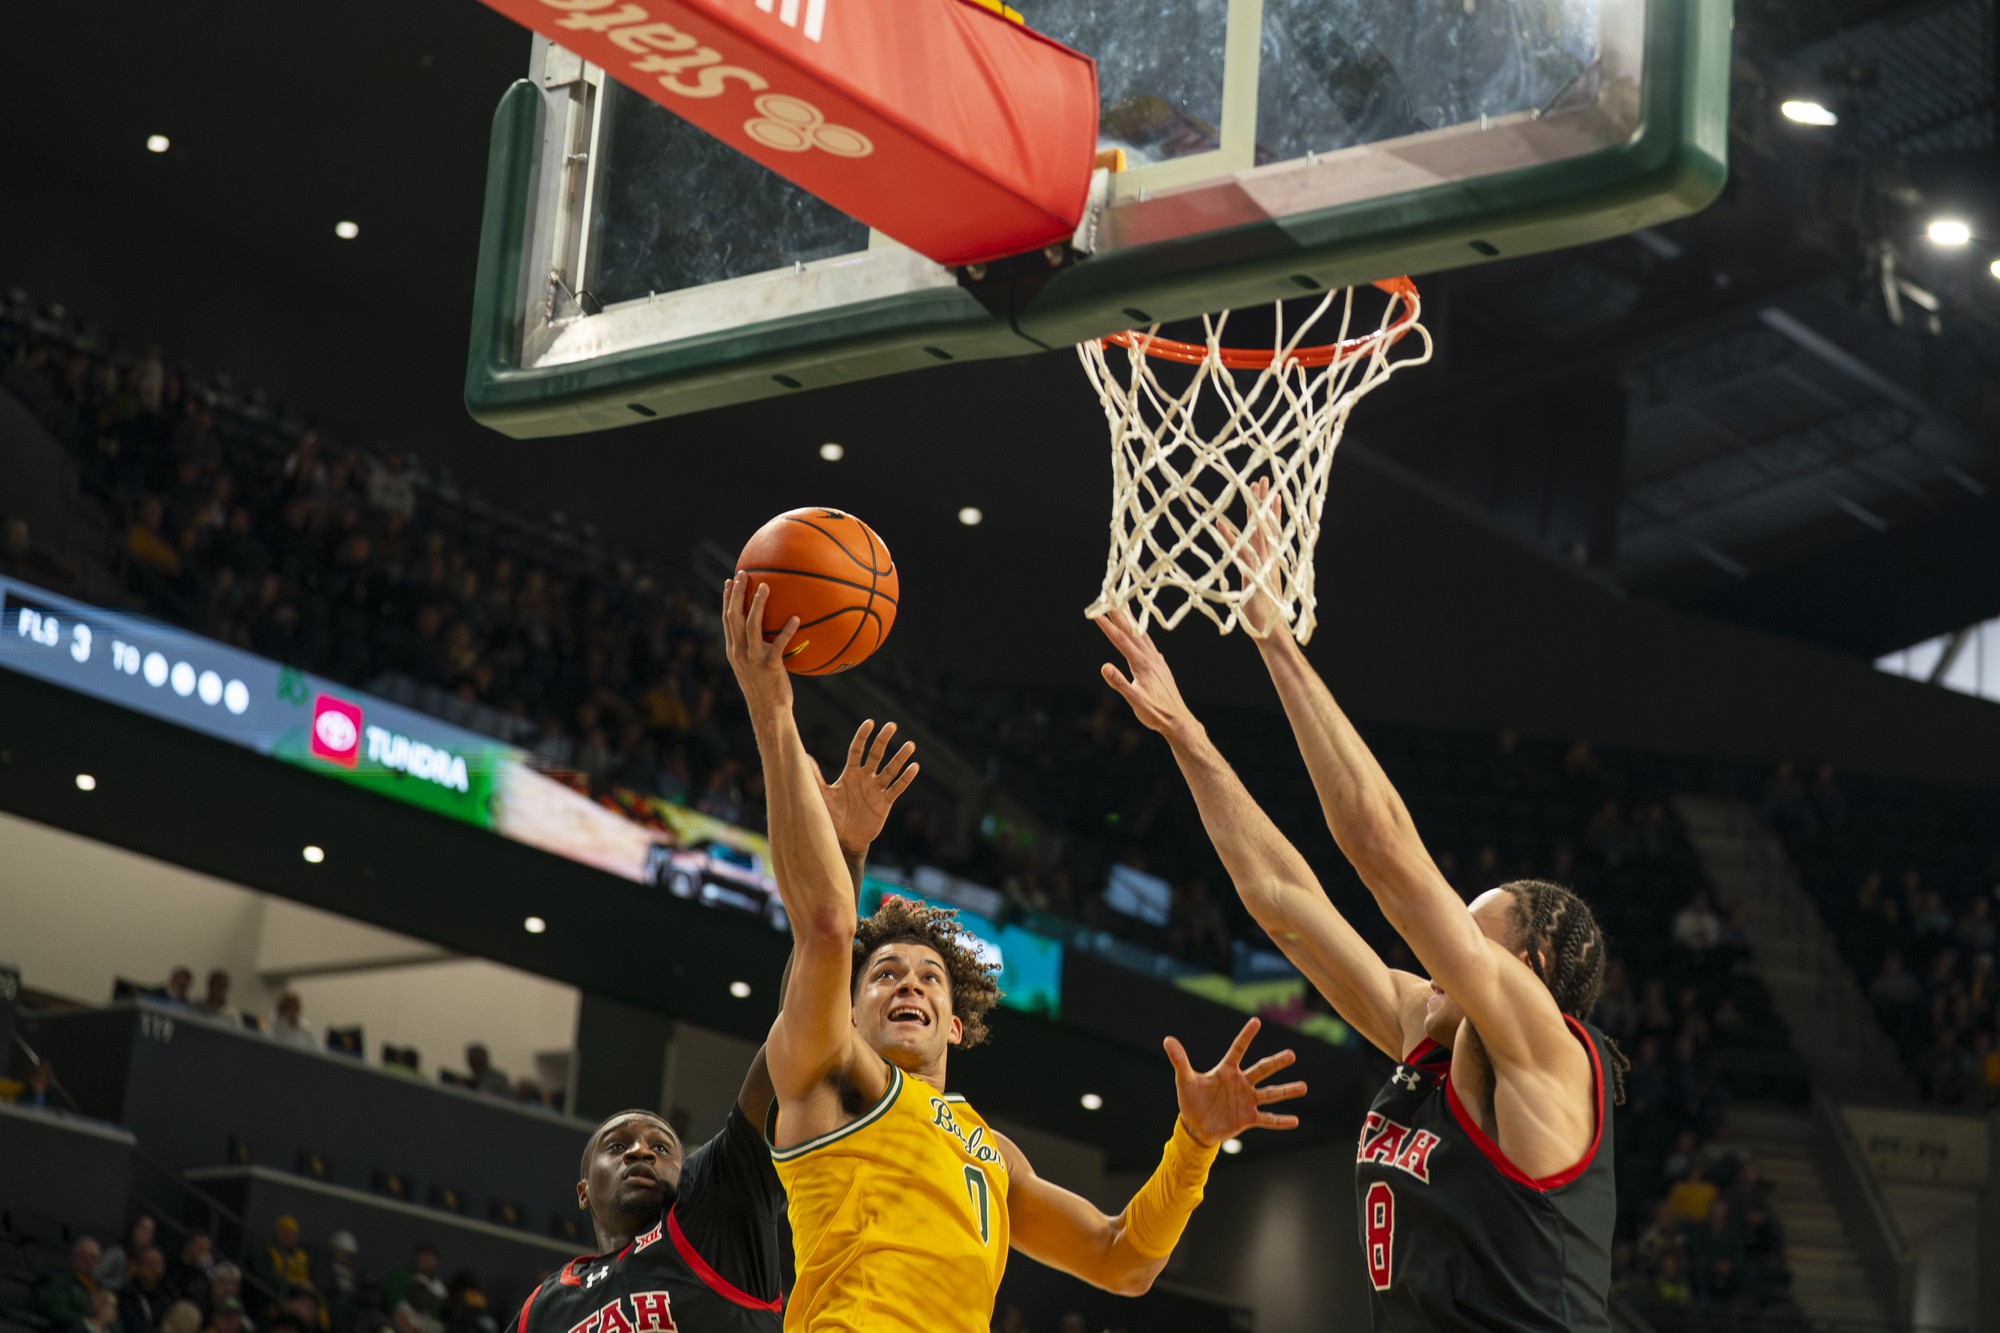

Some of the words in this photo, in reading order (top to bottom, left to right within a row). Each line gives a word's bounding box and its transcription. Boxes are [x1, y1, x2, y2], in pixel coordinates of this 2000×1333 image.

[18, 607, 59, 647] FLS
[70, 623, 92, 663] 3
[111, 640, 141, 675] TO
[366, 725, 469, 793] TUNDRA
[930, 1097, 1005, 1172] Balor
[634, 1220, 662, 1254] XII
[1365, 1181, 1395, 1291] 8
